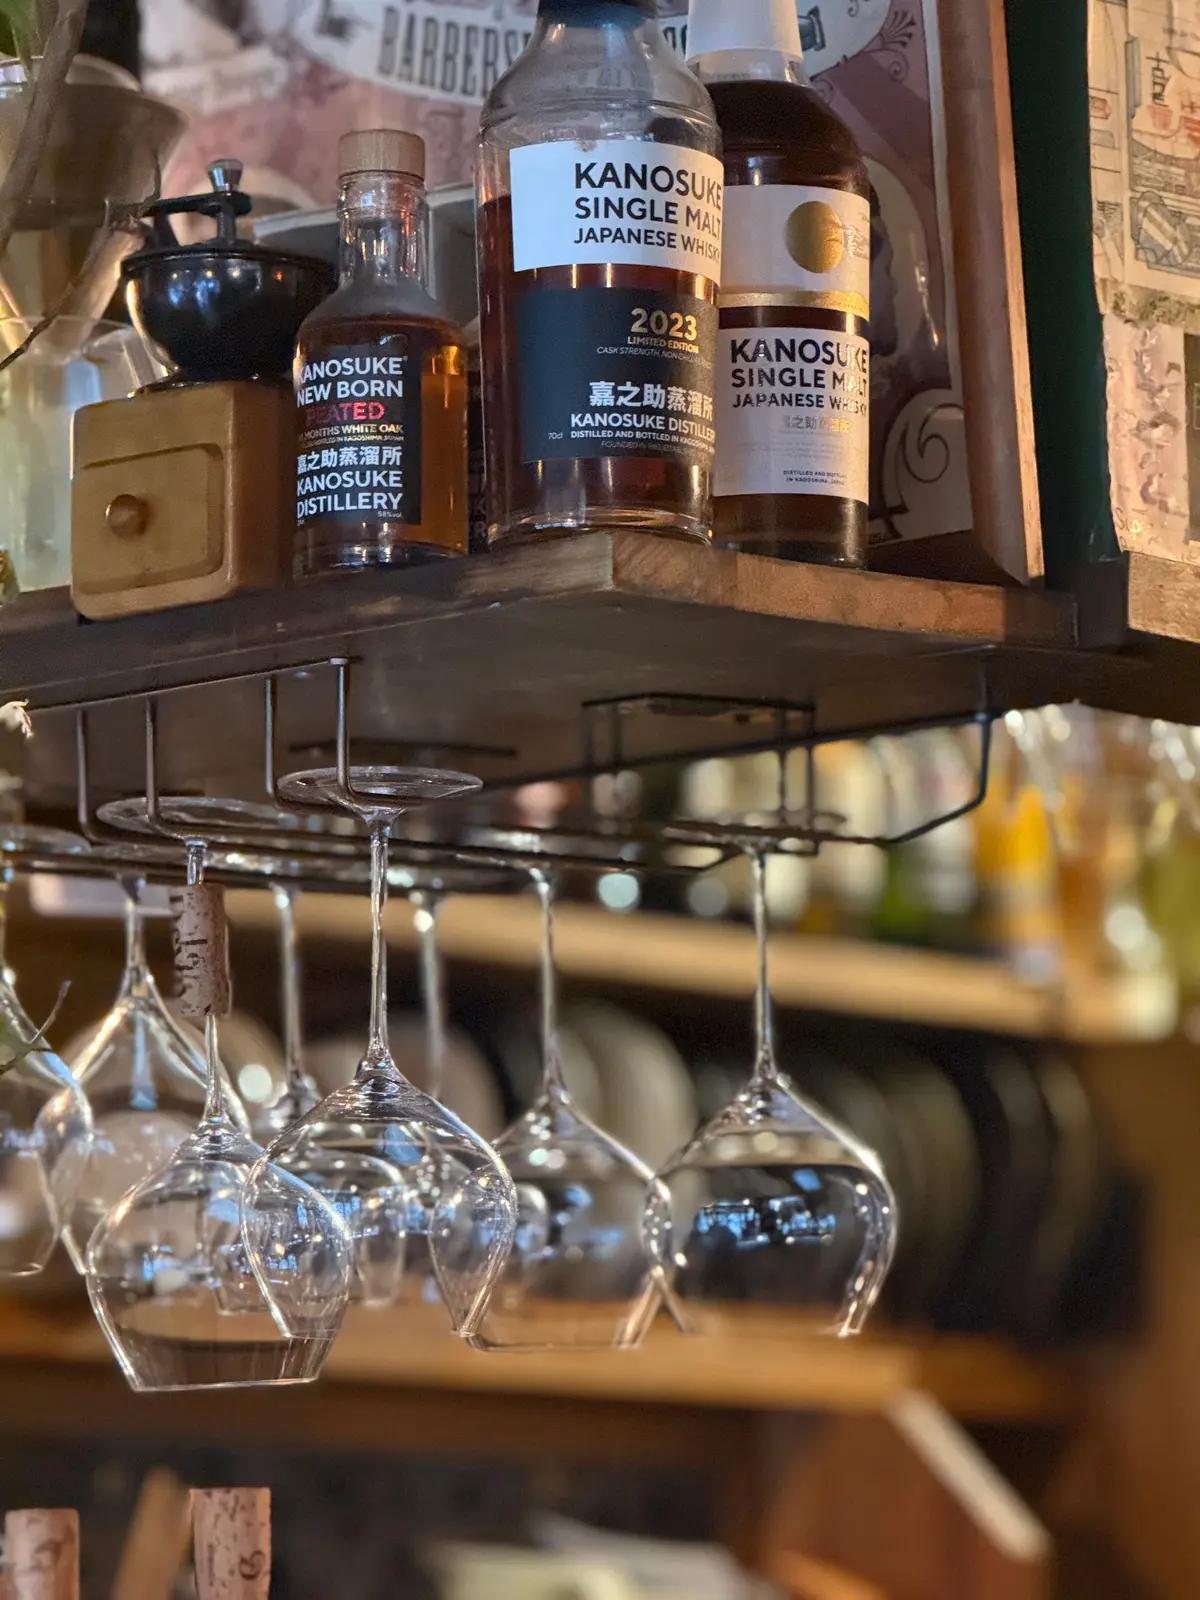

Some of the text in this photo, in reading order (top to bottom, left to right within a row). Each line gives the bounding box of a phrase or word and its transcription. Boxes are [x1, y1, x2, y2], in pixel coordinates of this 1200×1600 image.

[575, 162, 722, 212] KANOSUKE
[574, 196, 721, 240] SINGLE MALT
[573, 227, 677, 249] JAPANESE
[630, 307, 698, 341] 2023
[596, 346, 618, 354] CASK
[627, 335, 699, 354] LIMITED EDITION
[730, 337, 868, 374] KANOSUKE
[297, 379, 403, 408] NEW BORN
[731, 367, 867, 398] SINGLE MALT
[305, 401, 386, 425] PEATED
[588, 380, 713, 422] 嘉之助蒸溜所
[732, 392, 825, 409] JAPANESE
[341, 423, 378, 434] WHITE
[379, 423, 404, 434] OAK
[570, 412, 716, 444] KANOSUKE DISTILLER
[570, 430, 614, 439] DISTILLED
[614, 430, 634, 439] AND
[635, 431, 671, 442] BOTTLED
[671, 435, 680, 443] IN
[296, 446, 403, 475] 嘉之助蒸溜所
[296, 470, 403, 497] KANOSUKE
[296, 492, 404, 519] DISTILLERY
